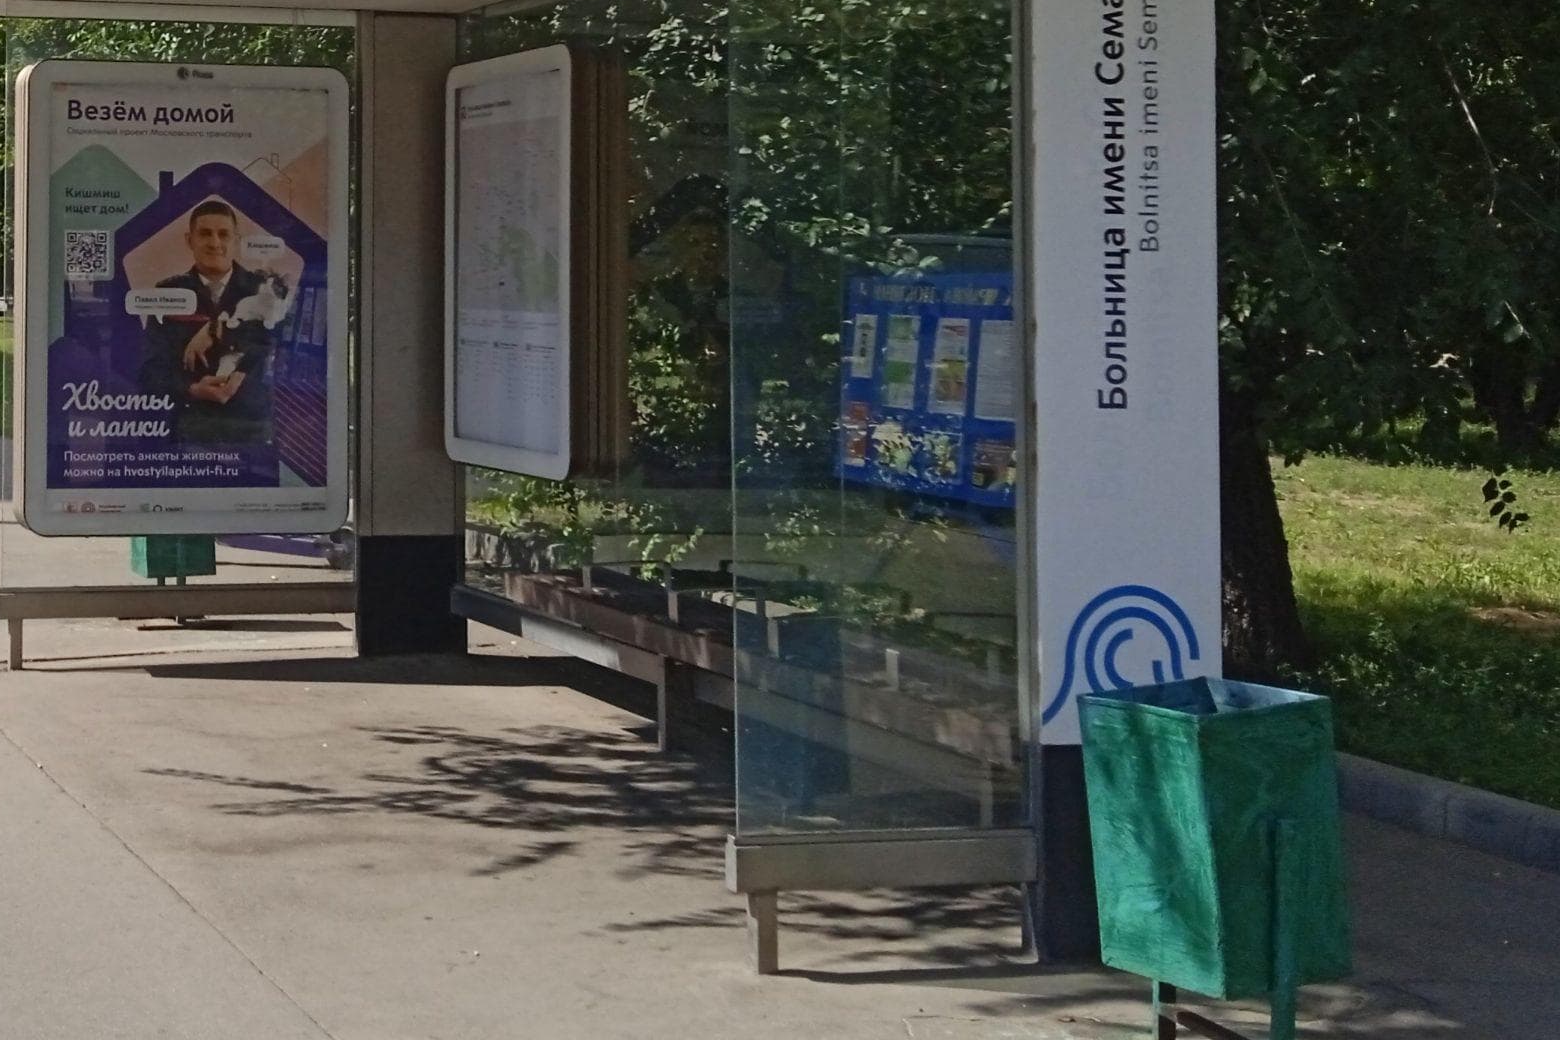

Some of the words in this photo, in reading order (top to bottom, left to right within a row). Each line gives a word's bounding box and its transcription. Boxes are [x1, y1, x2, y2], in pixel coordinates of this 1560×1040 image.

[1138, 61, 1159, 133] imeni
[68, 100, 147, 121] Везём
[153, 103, 235, 126] домой
[1102, 97, 1126, 215] имени
[65, 187, 121, 199] Кишмиш
[1138, 145, 1159, 253] Bolnitsa
[65, 204, 97, 215] ищет
[99, 203, 129, 215] дом!
[1097, 228, 1130, 410] Больница
[62, 379, 175, 411] Хвосты
[67, 420, 87, 438] и
[90, 420, 170, 438] лапки
[64, 450, 136, 462] Посмотреть
[138, 452, 179, 461] анкеты
[181, 451, 240, 461] животных
[64, 467, 105, 477] можно
[107, 468, 121, 477] на
[123, 465, 239, 478] hvostyilapki.wi-fi.ru
